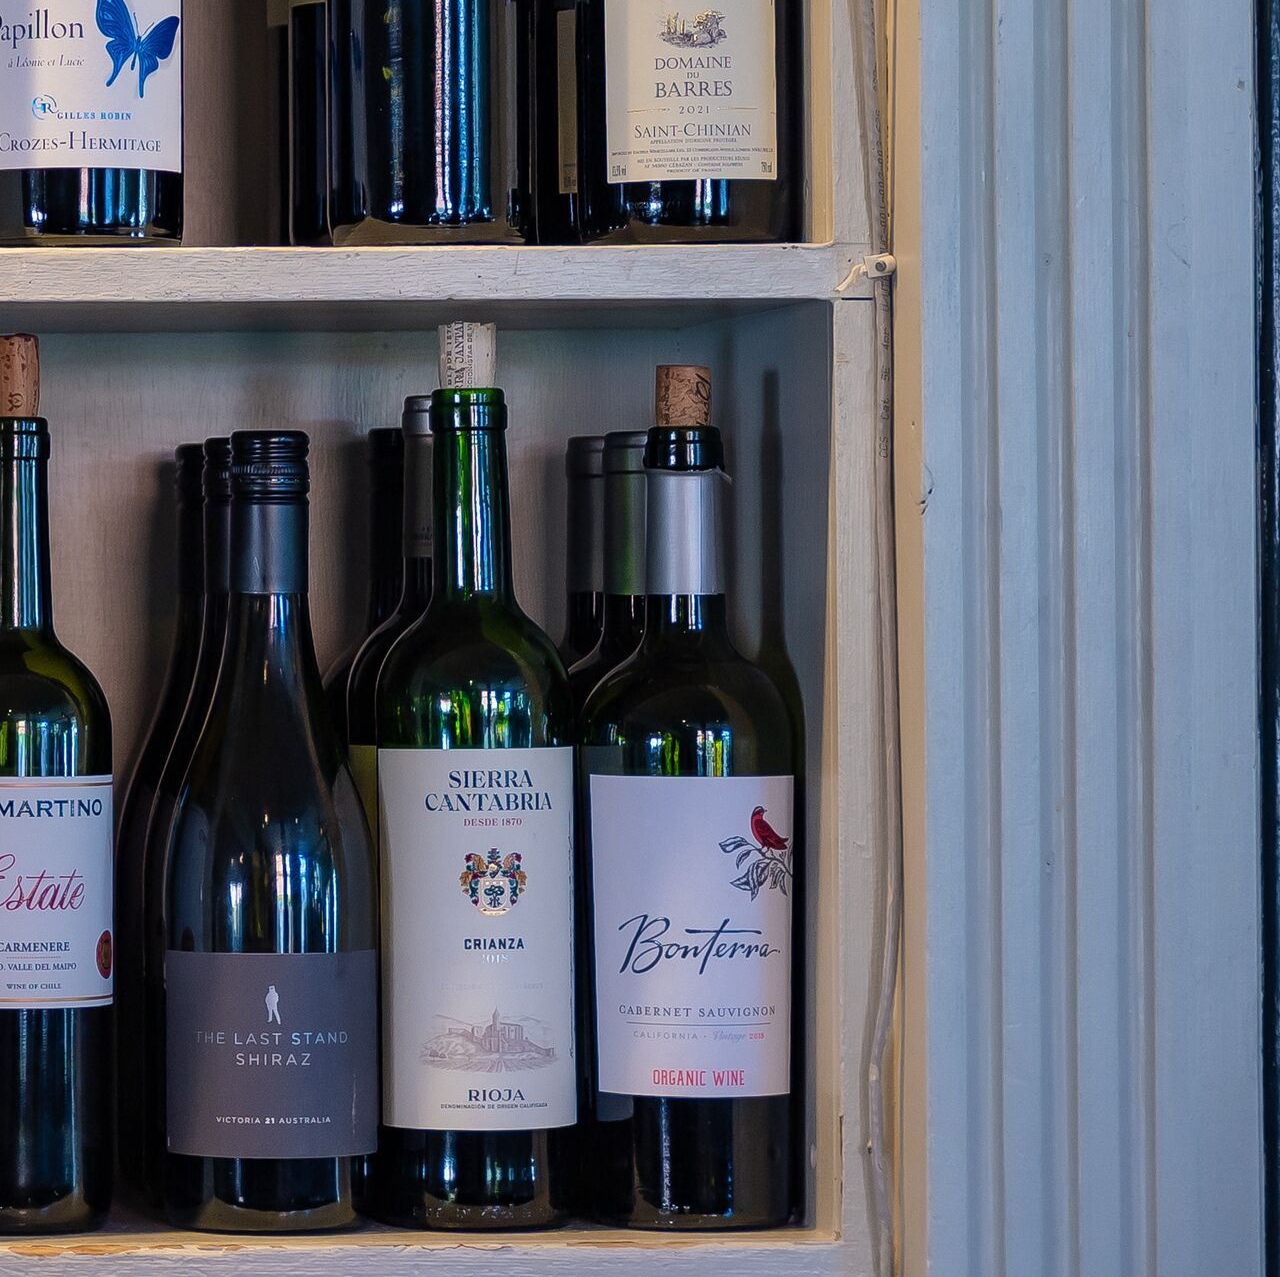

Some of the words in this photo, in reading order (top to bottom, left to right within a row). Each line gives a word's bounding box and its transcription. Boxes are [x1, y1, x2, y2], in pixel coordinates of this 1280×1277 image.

[654, 56, 732, 71] DOMAINE
[654, 81, 733, 99] BARRES
[57, 112, 96, 120] GILLES
[100, 112, 132, 121] ROBIN
[679, 105, 710, 115] 2021
[634, 123, 752, 139] SAINT-CHINIAN
[448, 769, 534, 789] SIERRA
[425, 792, 552, 812] CANTABRIA
[463, 818, 498, 826] DESDE
[501, 818, 523, 826] 1870
[464, 938, 525, 950] CRIANZA
[618, 913, 781, 975] Bonterra
[7, 963, 33, 971] VALLE
[35, 963, 51, 971] DEL
[52, 962, 77, 971] MAIPO
[619, 1004, 692, 1017] CABERNET
[699, 1005, 775, 1017] SAUVIGNON
[195, 1032, 225, 1044] THE
[234, 1032, 282, 1045] LAST
[291, 1031, 348, 1045] STAND
[633, 1030, 698, 1040] CALIFORNIA
[235, 1053, 311, 1066] SHIRAZ
[653, 1069, 706, 1086] ORGANIC
[713, 1070, 745, 1086] WINE
[468, 1089, 525, 1102] RIOJA
[216, 1116, 261, 1124] VICTORIA
[279, 1116, 331, 1124] AUSTRALIA
